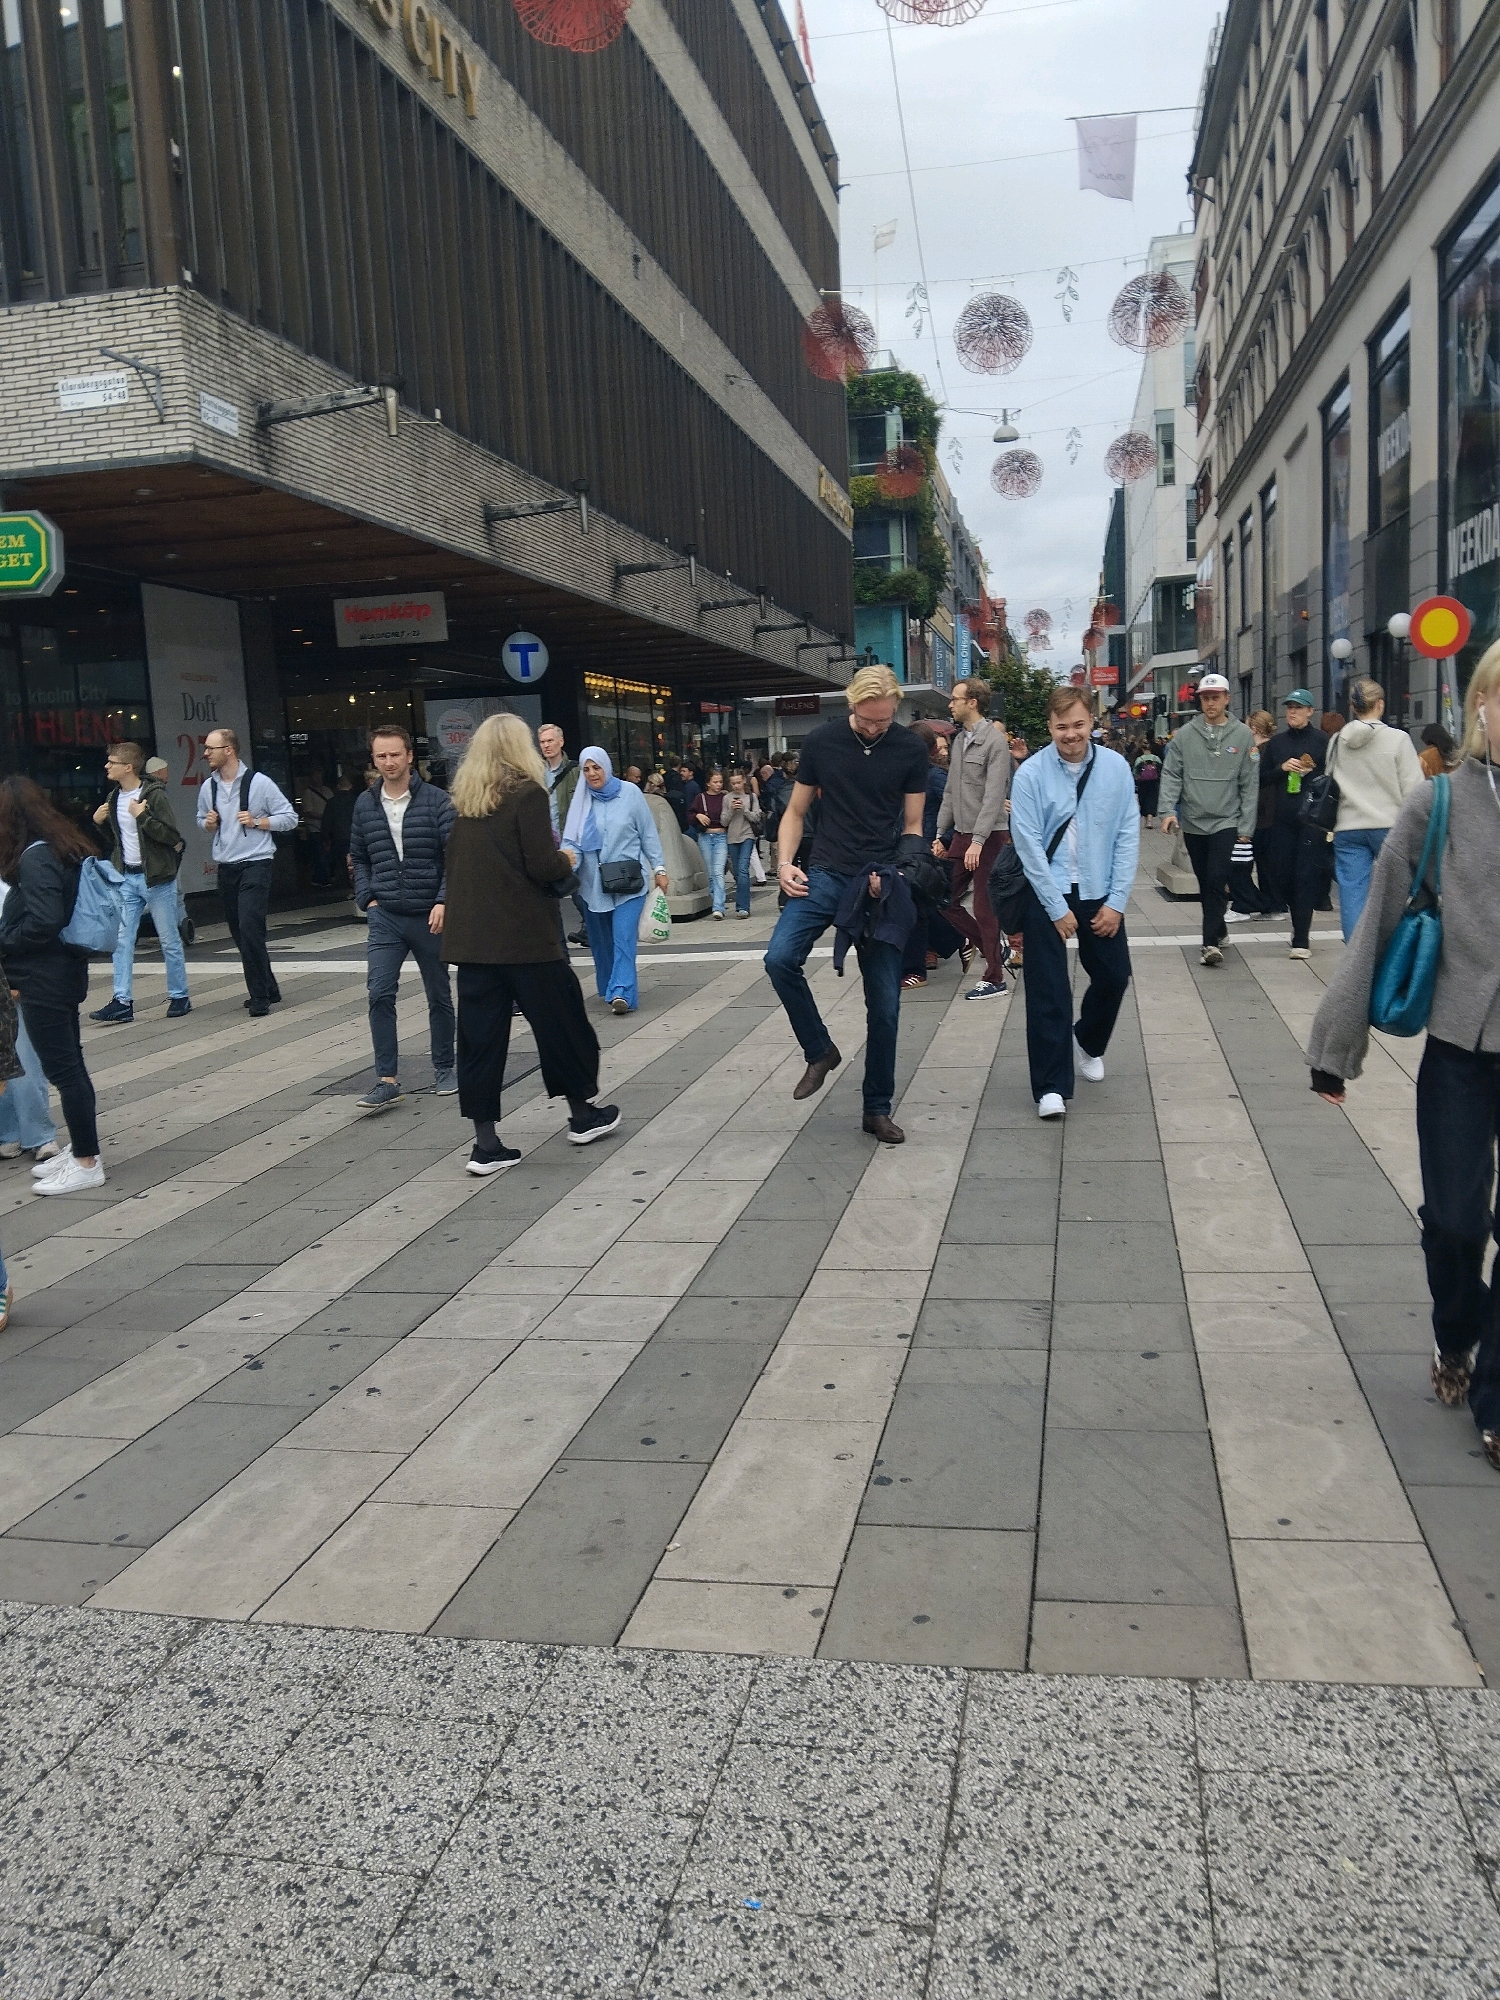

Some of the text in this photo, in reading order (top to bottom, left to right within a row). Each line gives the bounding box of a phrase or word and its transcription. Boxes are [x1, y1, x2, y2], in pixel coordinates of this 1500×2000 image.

[401, 0, 480, 119] CITY
[344, 601, 433, 624] Hemköp
[508, 643, 539, 677] T
